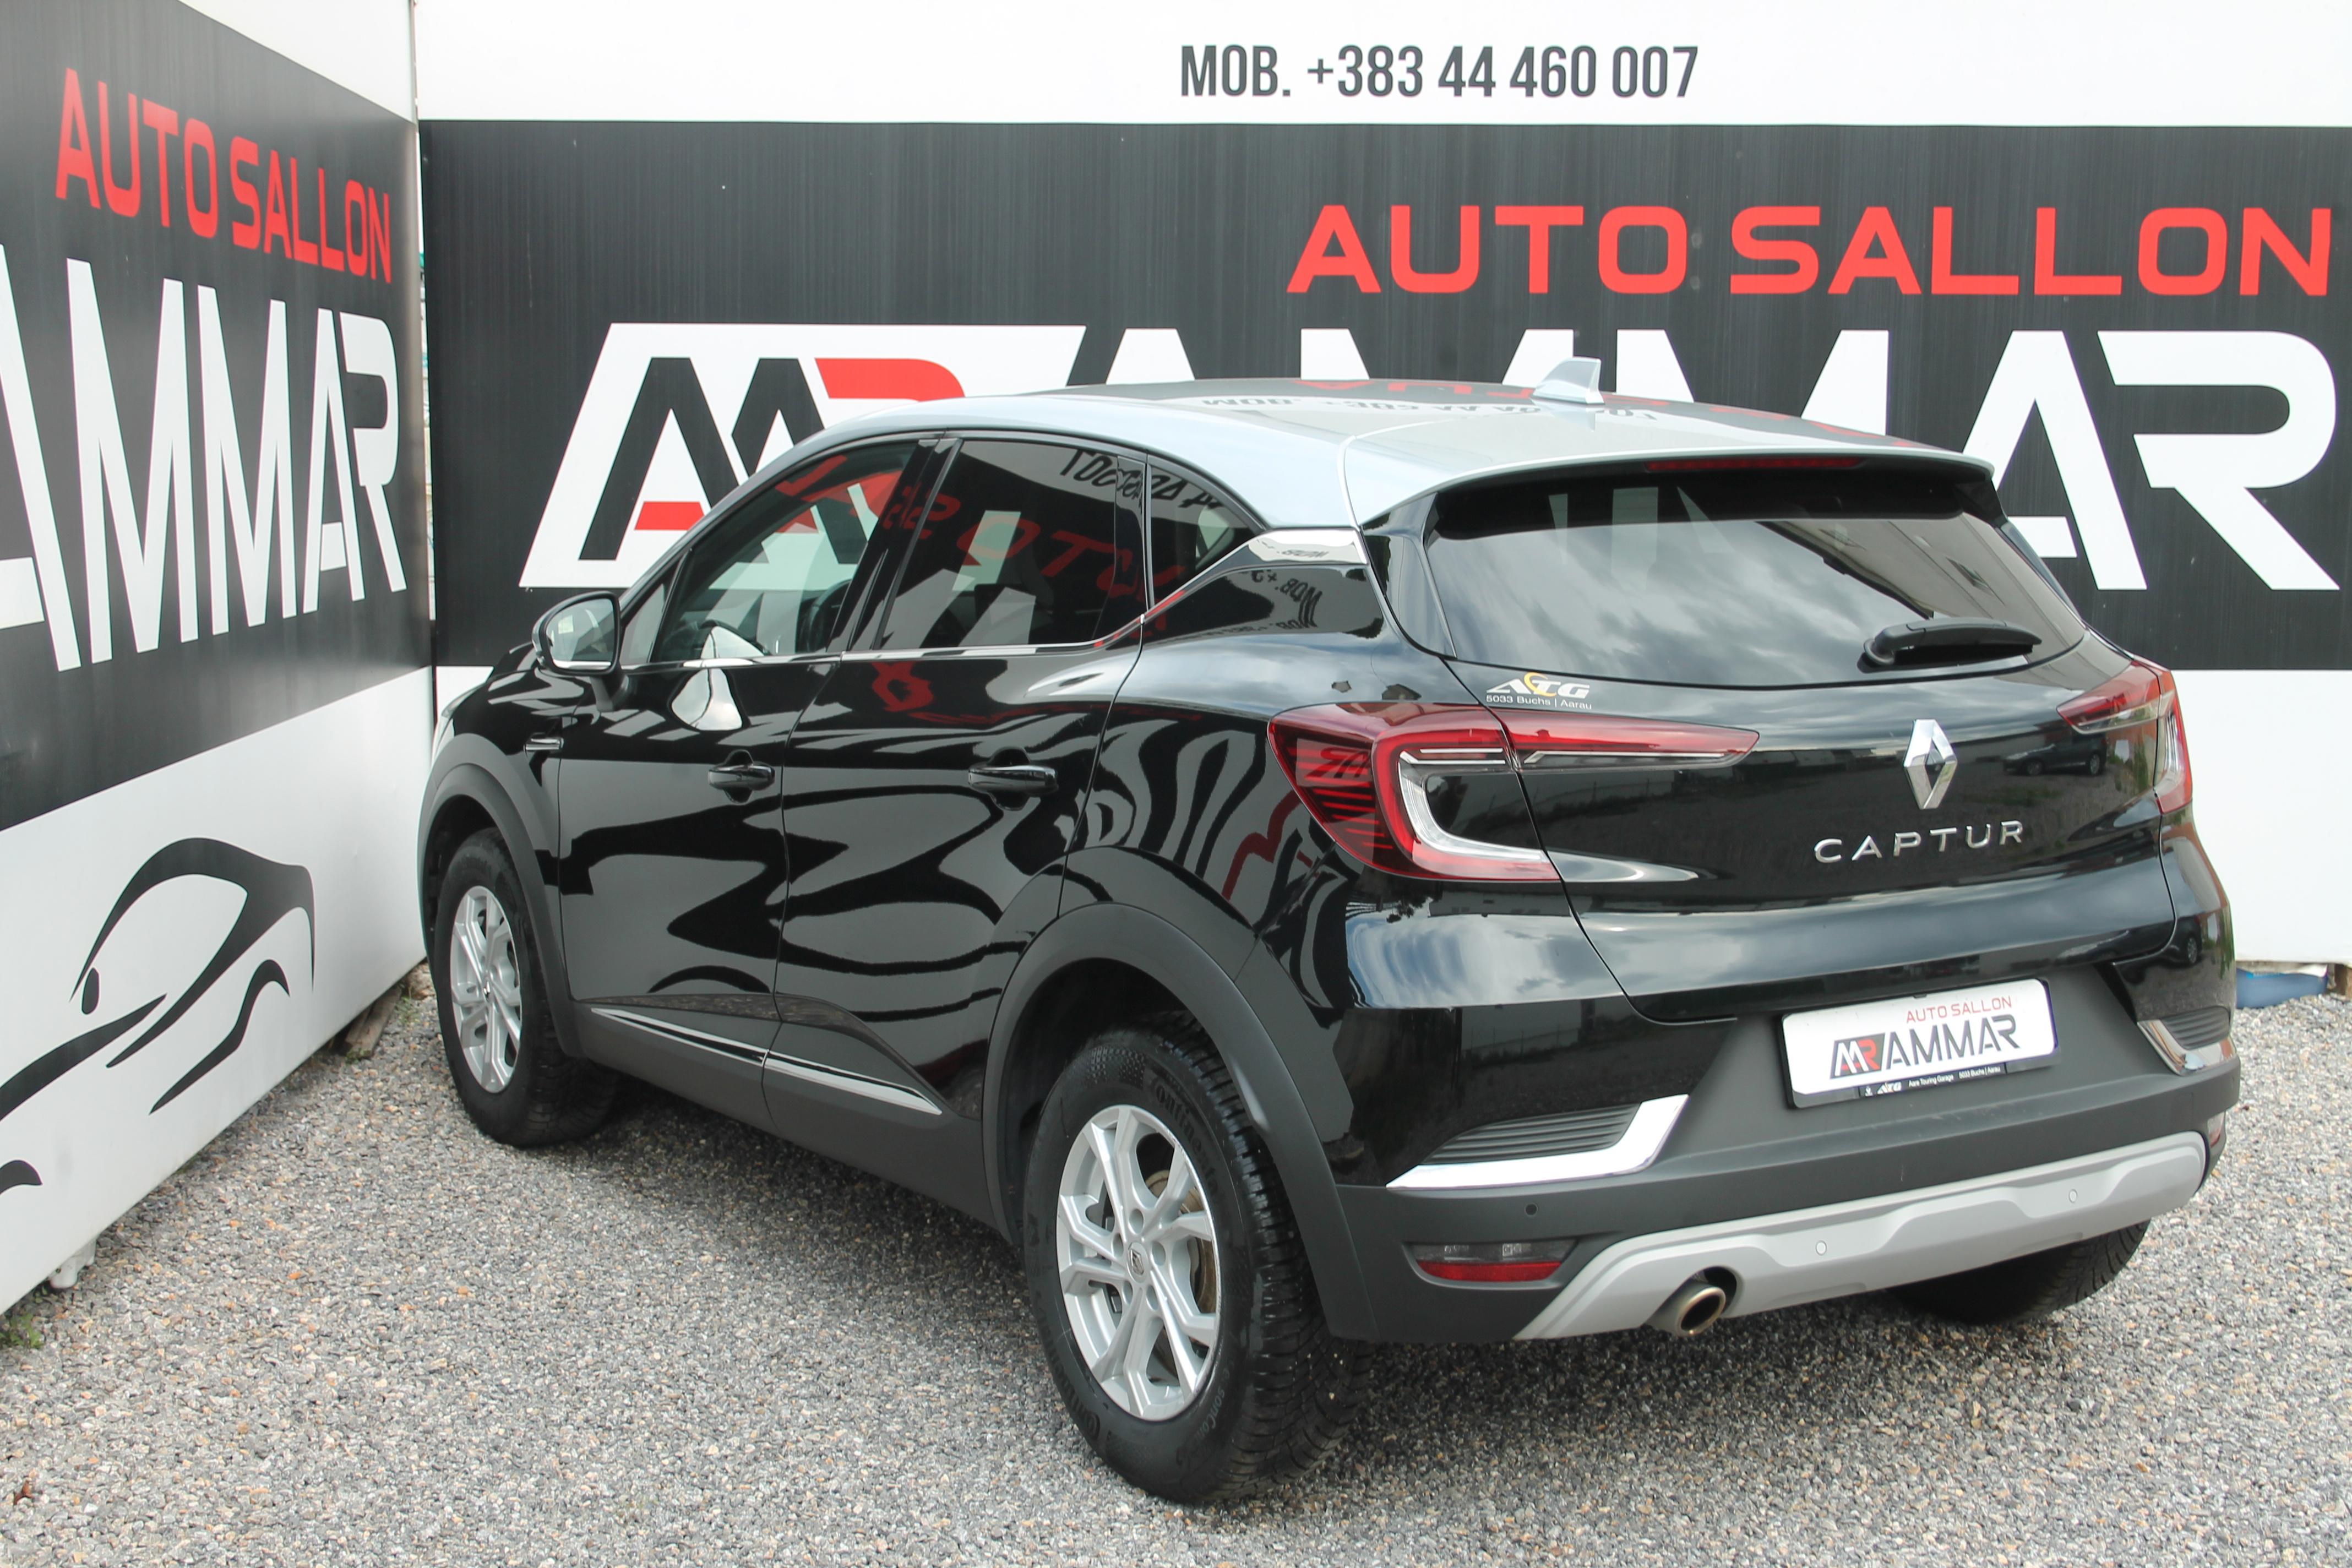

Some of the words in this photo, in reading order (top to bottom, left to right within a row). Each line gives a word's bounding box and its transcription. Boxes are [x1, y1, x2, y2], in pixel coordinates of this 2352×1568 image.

[1181, 45, 1291, 97] MOB.
[1308, 45, 1424, 97] +383
[1438, 46, 1496, 97] 44
[1510, 45, 1597, 97] 460
[1612, 46, 1698, 98] 007
[56, 68, 219, 239] AUTO
[230, 135, 392, 284] SALLON
[1286, 204, 1688, 294] AUTO
[1730, 205, 2332, 296] SALLON
[1486, 694, 1513, 704] 5033
[1516, 695, 1551, 707] Buchs
[1560, 698, 1592, 710] Aarau
[1814, 820, 2024, 864] CAPTUR
[1906, 1005, 1948, 1024] AUTO
[1951, 995, 2013, 1017] SALLON
[1886, 1014, 2021, 1070] AMMAR
[1920, 1076, 1937, 1086] Touring
[1937, 1073, 1954, 1084] Garage
